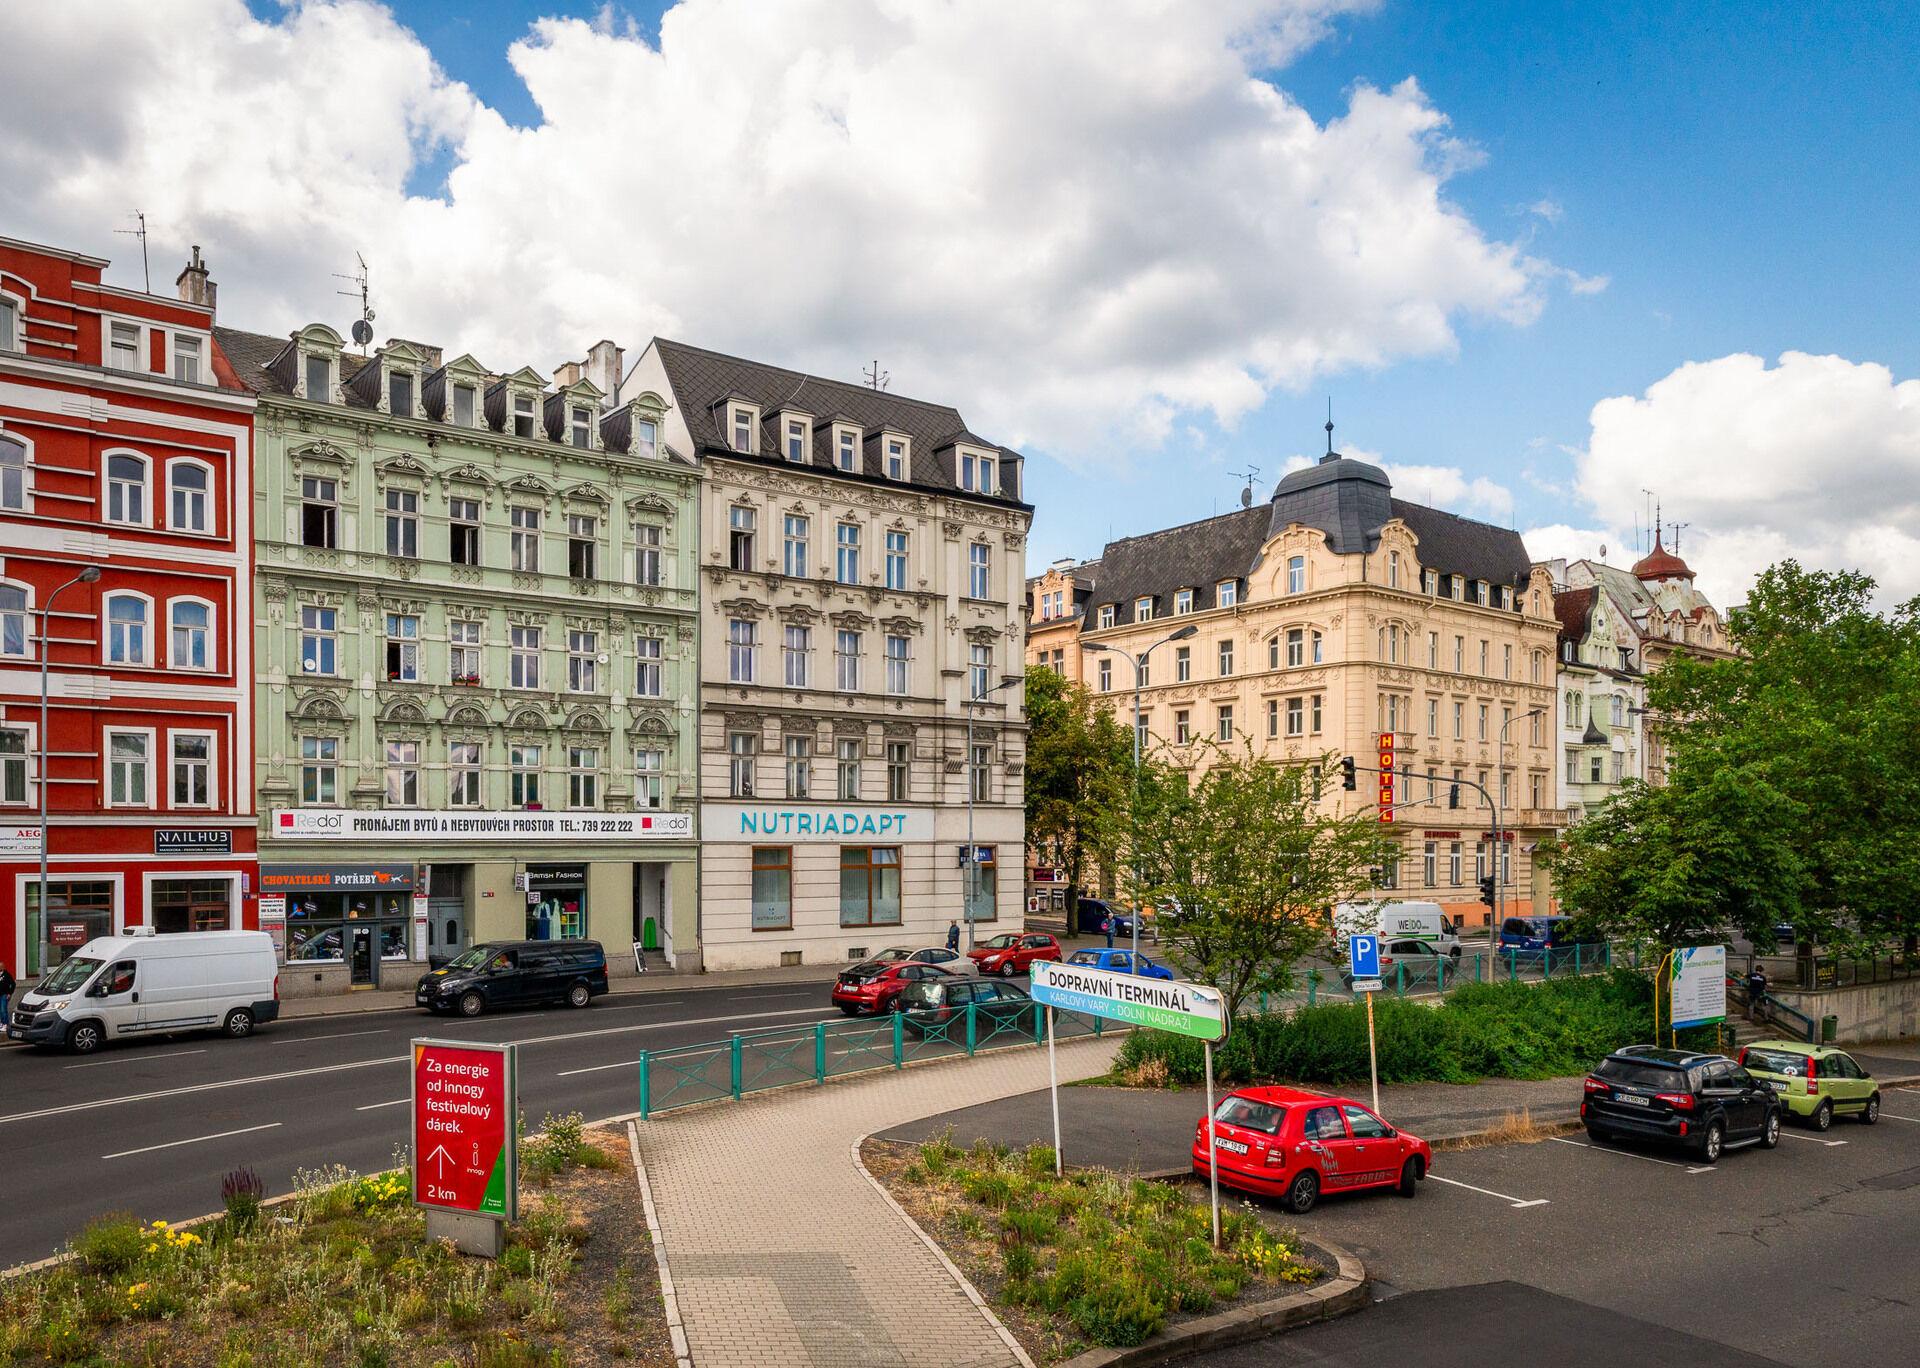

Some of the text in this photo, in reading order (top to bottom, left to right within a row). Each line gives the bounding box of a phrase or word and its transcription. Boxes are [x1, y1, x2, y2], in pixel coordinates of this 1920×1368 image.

[1381, 735, 1392, 820] HOTEL
[353, 816, 633, 832] PRONÁJEM BYTŮ A NEBYTOVÝCH PROSTOR TEL.: 739 222 222
[741, 811, 907, 835] NUTRIADAPT
[16, 829, 41, 838] AEG
[159, 831, 228, 842] NAILHUB
[262, 873, 331, 885] CHOVATELSKÉ
[335, 873, 377, 885] POTŘEBY
[1356, 938, 1371, 961] P
[1049, 971, 1113, 998] DOPRAVNÍ
[1116, 982, 1191, 1013] TERMINÁL
[1050, 992, 1087, 1009] KARLOVY
[1088, 1000, 1111, 1013] VARY
[1117, 1005, 1145, 1021] DOLNÍ
[1147, 1010, 1192, 1031] NÁDRAŽÍ
[426, 1058, 490, 1079] Za energie
[426, 1080, 485, 1099] od innogy
[426, 1098, 491, 1120] festivalový
[426, 1118, 464, 1134] dárek.
[466, 1167, 485, 1176] innogy
[427, 1184, 457, 1201] 2 km
